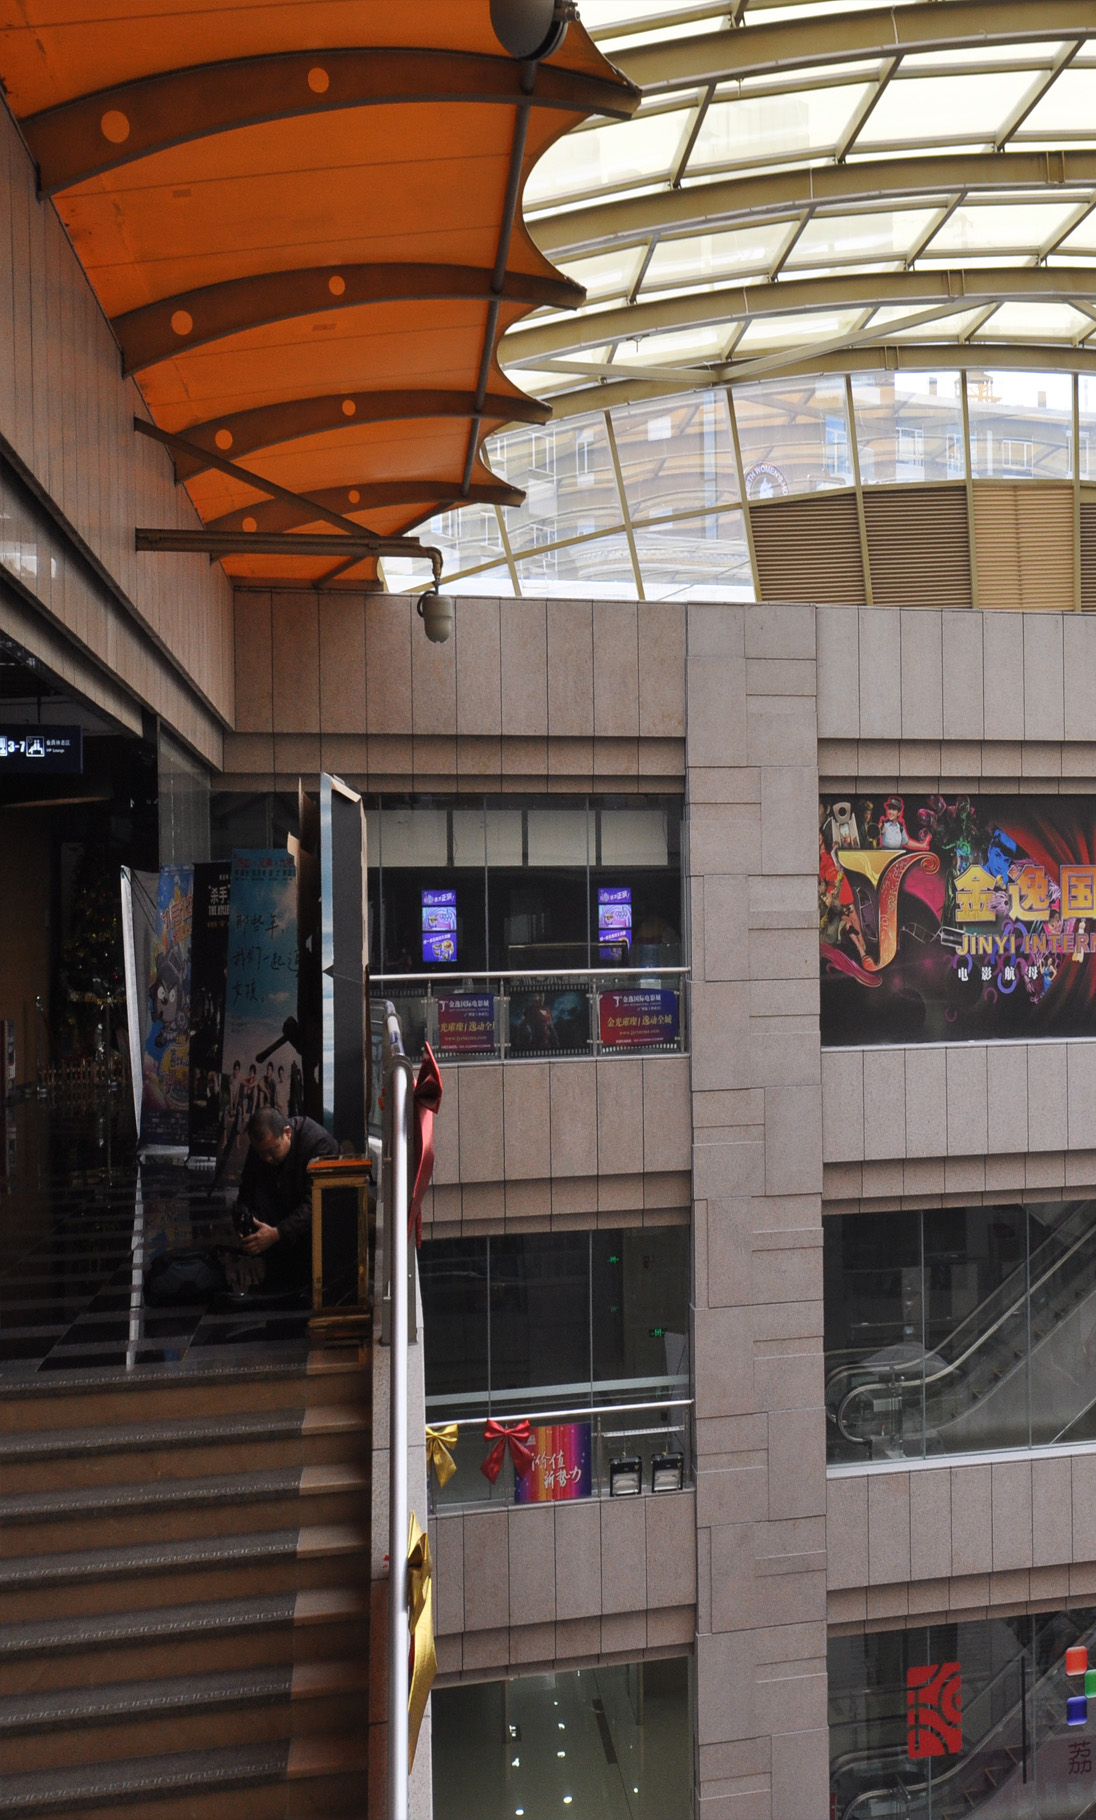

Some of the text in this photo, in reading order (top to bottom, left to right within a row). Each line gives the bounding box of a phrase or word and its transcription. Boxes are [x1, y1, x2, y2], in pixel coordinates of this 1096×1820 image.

[7, 740, 26, 753] 3-7
[956, 933, 1016, 956] JINYI
[957, 965, 1039, 982] 电影航母
[543, 1466, 582, 1490] 新势力
